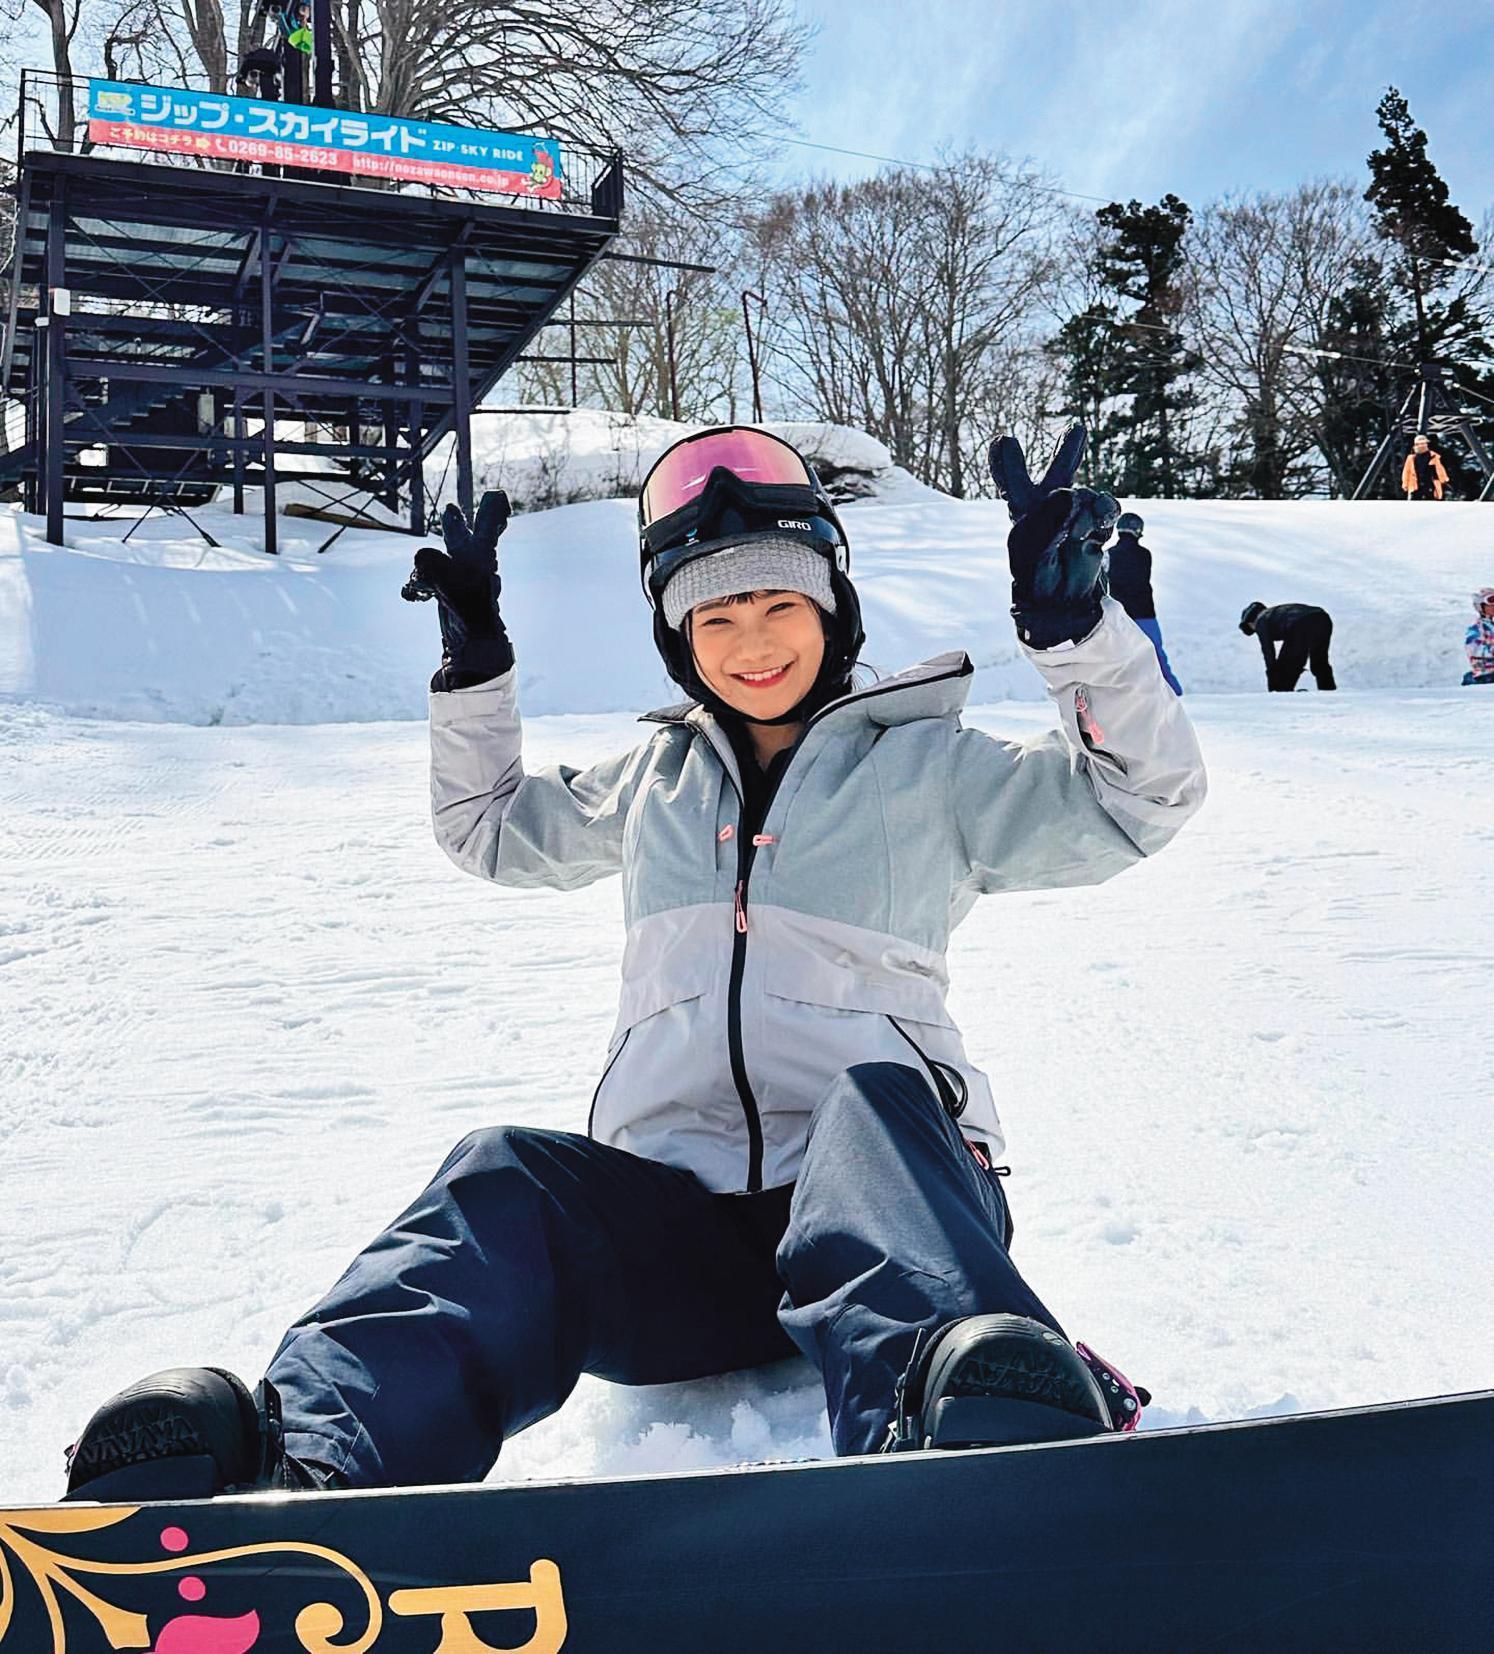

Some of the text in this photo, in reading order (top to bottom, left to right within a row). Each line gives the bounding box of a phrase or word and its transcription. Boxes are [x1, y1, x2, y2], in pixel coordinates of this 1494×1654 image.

[140, 94, 427, 153] ジップ・スカイライド
[228, 139, 338, 166] 0269-85-2623
[492, 148, 524, 162] RIDE
[352, 156, 510, 188] http://nozawaonsen.co.jp
[777, 519, 812, 531] GIRO
